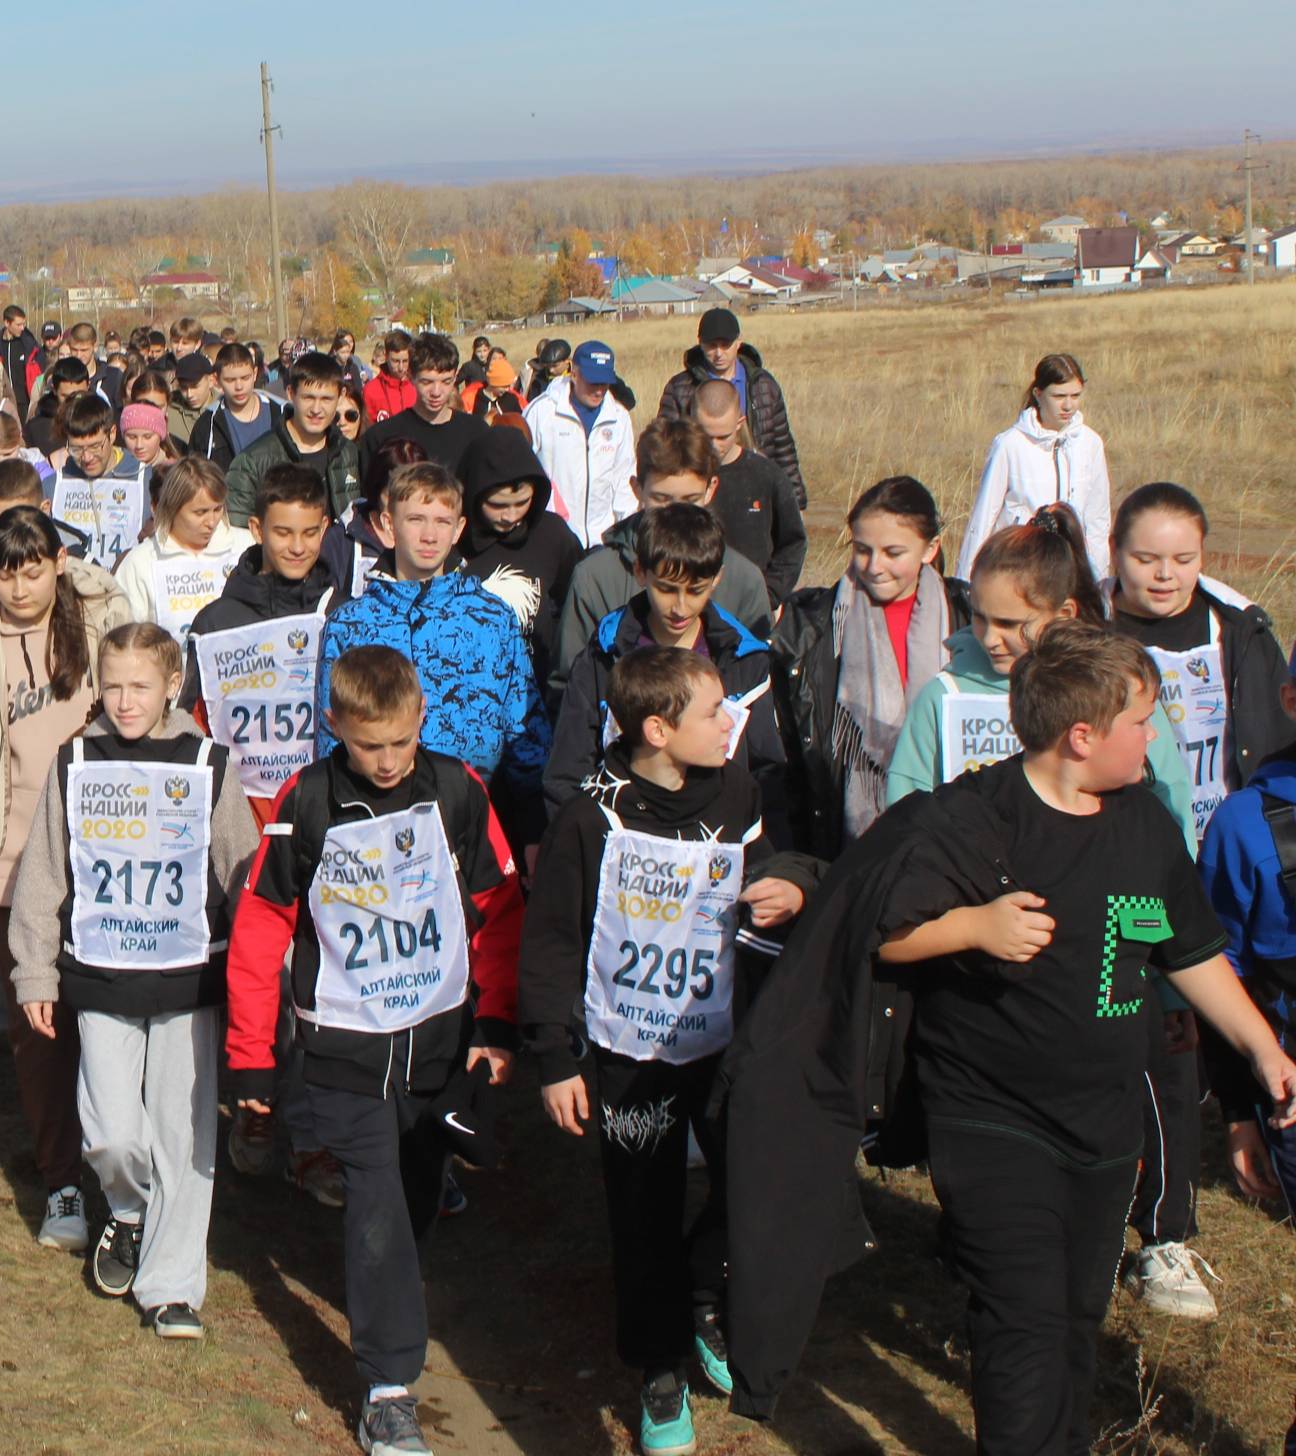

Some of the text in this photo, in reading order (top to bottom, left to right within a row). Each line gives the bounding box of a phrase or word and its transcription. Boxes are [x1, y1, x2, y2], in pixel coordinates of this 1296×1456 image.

[165, 571, 201, 585] КРОСС
[167, 581, 215, 596] НАЦИИ
[215, 644, 259, 666] КРОСС
[217, 656, 276, 680] НАЦИИ
[231, 702, 315, 745] 2152
[240, 752, 310, 766] АЛТАЙСКИЙ
[260, 767, 292, 781] КРАЙ
[81, 783, 132, 798] КРОСС
[81, 800, 147, 817] НАЦИИ
[81, 819, 146, 839] 2020
[619, 852, 677, 879] КРОСС
[92, 859, 184, 907] 2173
[618, 871, 689, 899] НАЦИИ
[320, 885, 389, 906] 2020
[616, 891, 682, 922] 2020
[100, 918, 180, 934] АЛТАЙСКИЙ
[120, 936, 157, 951] КРАЙ
[339, 908, 442, 970] 2104
[612, 940, 715, 1000] 2295
[360, 967, 441, 997] АЛТАЙСКИЙ
[384, 992, 419, 1009] КРАЙ
[616, 1002, 707, 1031] АЛТАЙСКИЙ
[638, 1028, 678, 1047] КРАЙ
